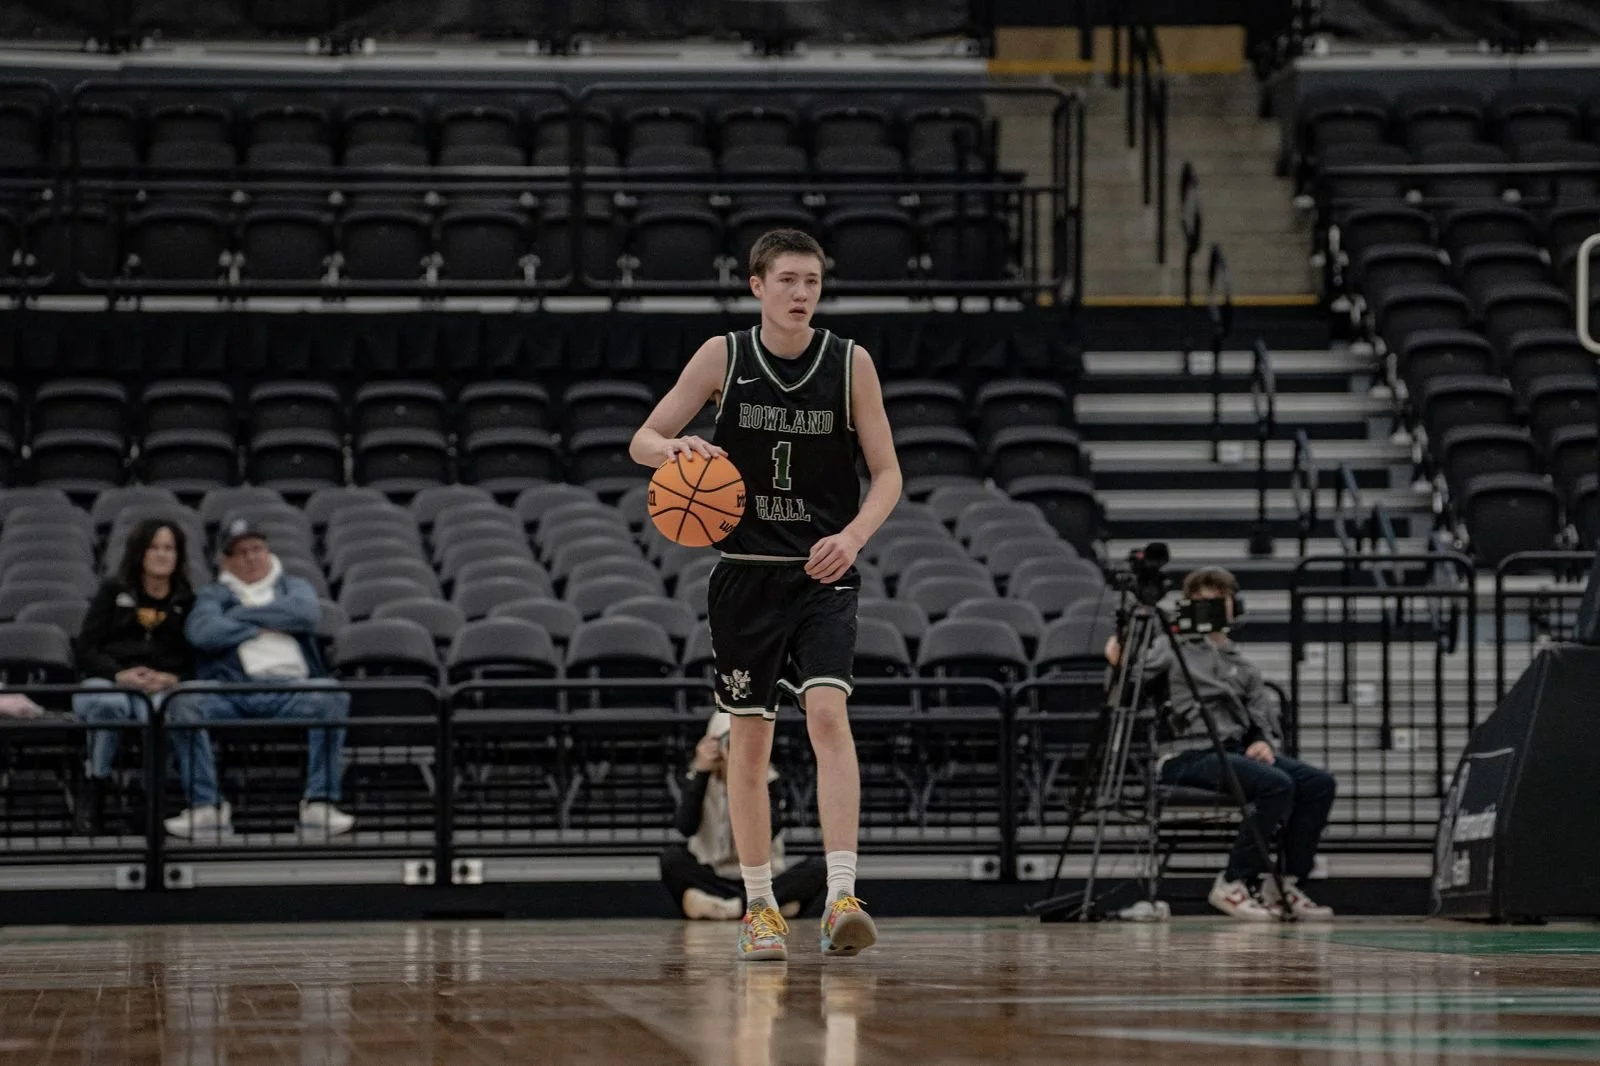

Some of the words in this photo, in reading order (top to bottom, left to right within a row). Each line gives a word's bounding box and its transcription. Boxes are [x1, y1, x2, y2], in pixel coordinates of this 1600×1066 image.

[739, 403, 834, 434] ROWLAND
[772, 441, 791, 490] 1
[756, 496, 811, 522] HALL
